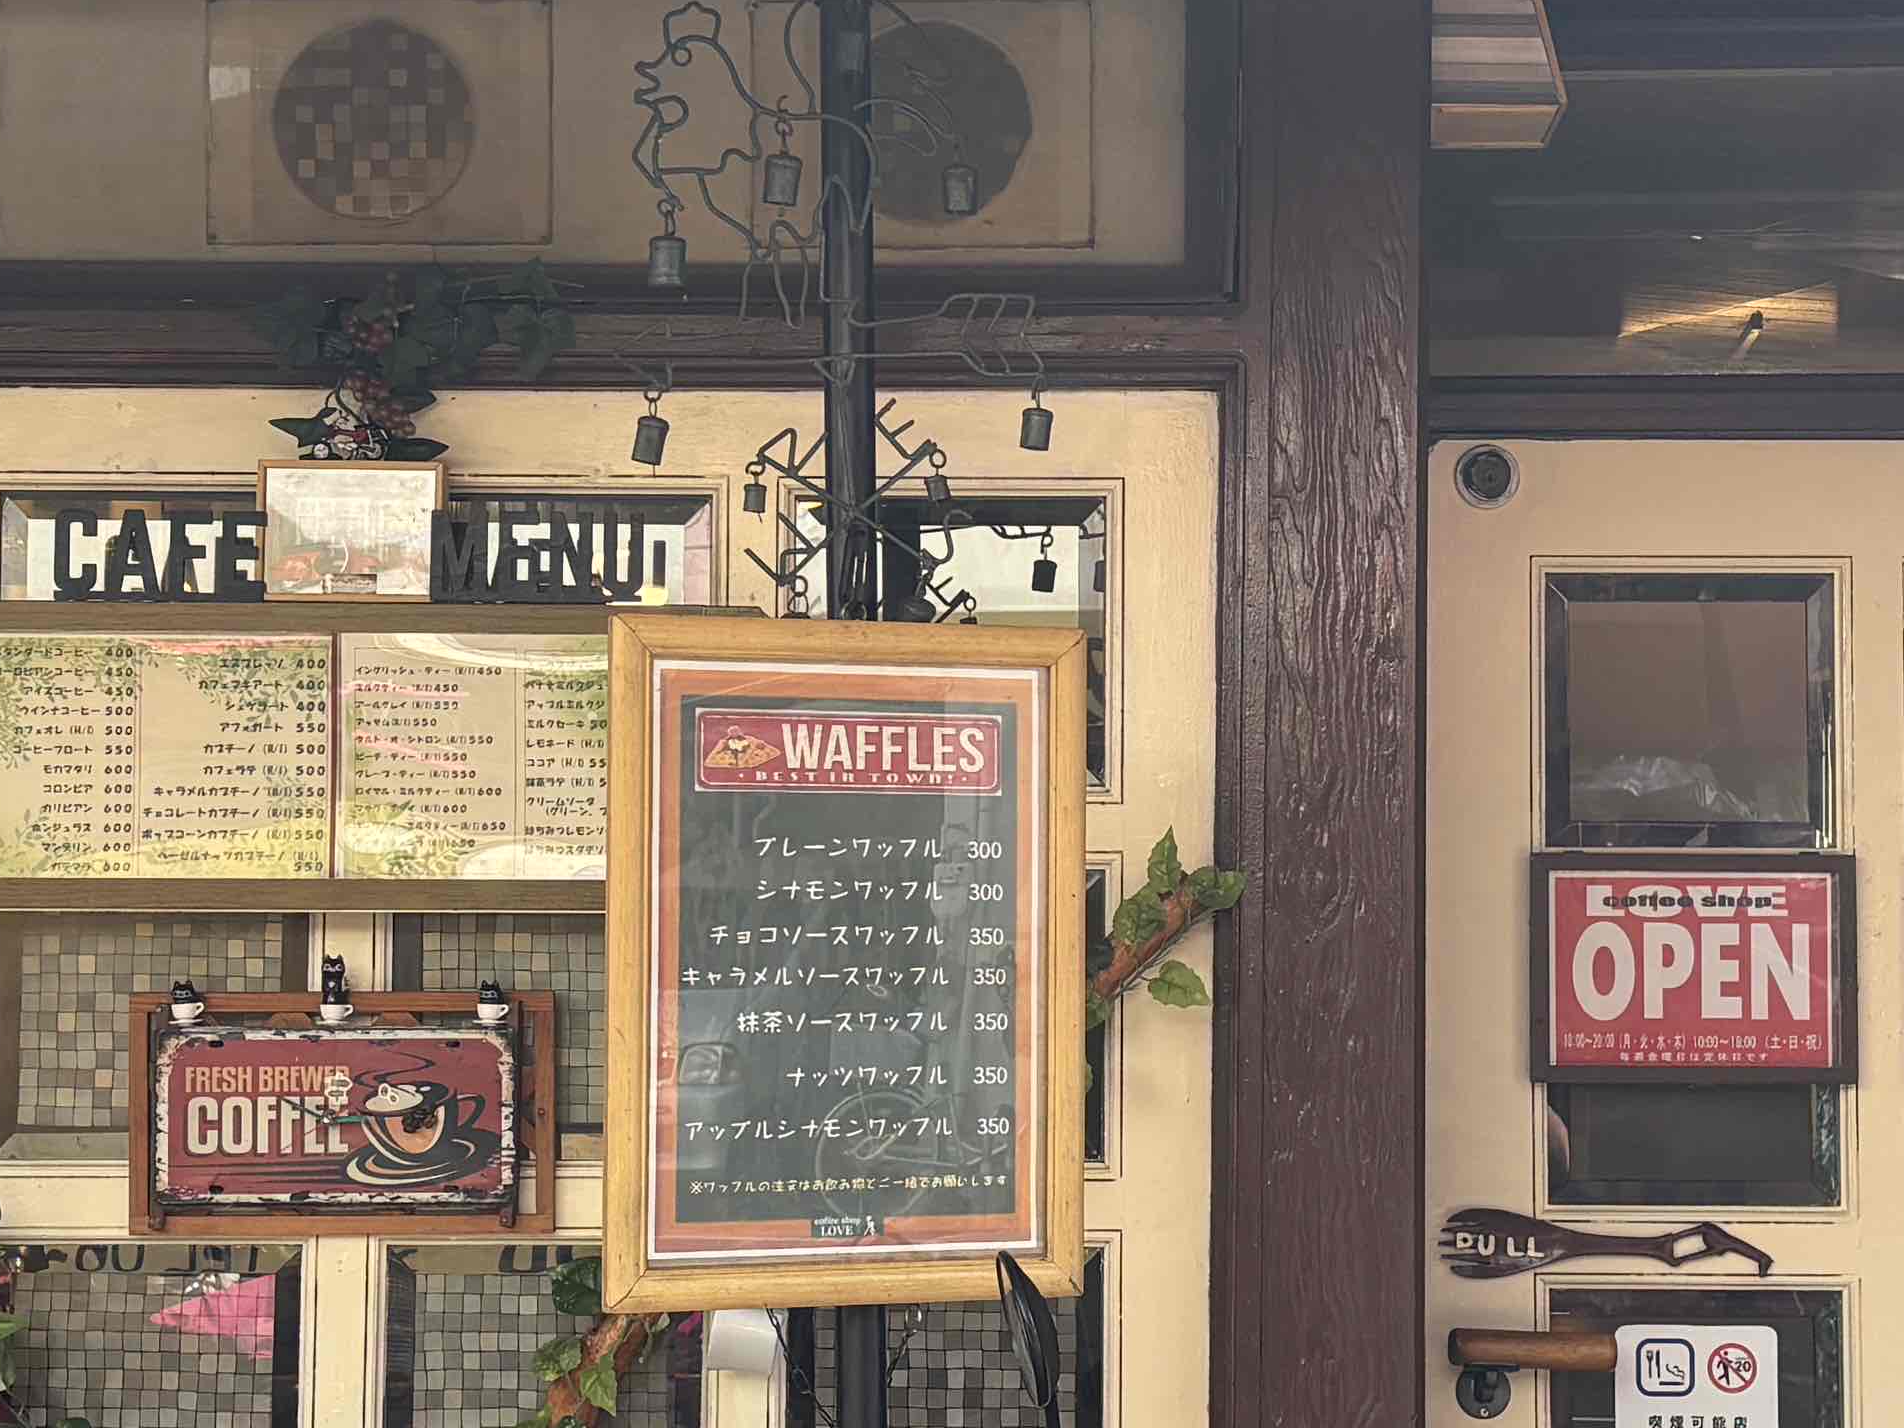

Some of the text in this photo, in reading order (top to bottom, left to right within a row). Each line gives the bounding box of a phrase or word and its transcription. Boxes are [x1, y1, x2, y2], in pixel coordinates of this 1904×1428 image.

[54, 504, 645, 602] CAFE MENU
[105, 648, 132, 657] 400
[296, 659, 325, 669] 400
[105, 667, 133, 676] 450
[296, 681, 325, 690] 400
[525, 680, 608, 691] バナナミルクジュ
[104, 687, 133, 696] 450
[105, 707, 133, 715] 500
[296, 702, 325, 711] 400
[105, 726, 132, 735] 500
[296, 723, 325, 732] 550
[105, 745, 132, 754] 550
[296, 744, 325, 754] 500
[782, 723, 985, 773] WAFFLES
[527, 758, 555, 767] ココア
[104, 765, 132, 773] 600
[296, 766, 325, 776] 500
[756, 771, 815, 781] BEST
[104, 785, 132, 793] 600
[295, 787, 325, 797] 550
[104, 804, 131, 813] 600
[295, 808, 324, 818] 550
[103, 824, 131, 833] 600
[295, 829, 323, 839] 550
[103, 843, 131, 852] 600
[753, 837, 1002, 859] プレーンワッフル 300
[103, 863, 130, 871] 600
[756, 881, 1003, 901] シナモンワッフル 300
[1586, 885, 1789, 918] LOVE
[710, 926, 1004, 946] チョコソースワッフル 350
[1572, 922, 1810, 1021] OPEN
[682, 967, 1007, 987] キャラメルソースワッフル 350
[737, 1012, 1008, 1034] 抹茶ソースワッフル 350
[185, 1066, 252, 1093] FRESH
[786, 1066, 1008, 1087] ナッツワッフル 350
[685, 1118, 1010, 1140] アップルシナモンワッフル 350
[821, 1225, 854, 1237] LOVE
[1456, 1232, 1545, 1258] PULL
[1734, 1361, 1751, 1372] 20
